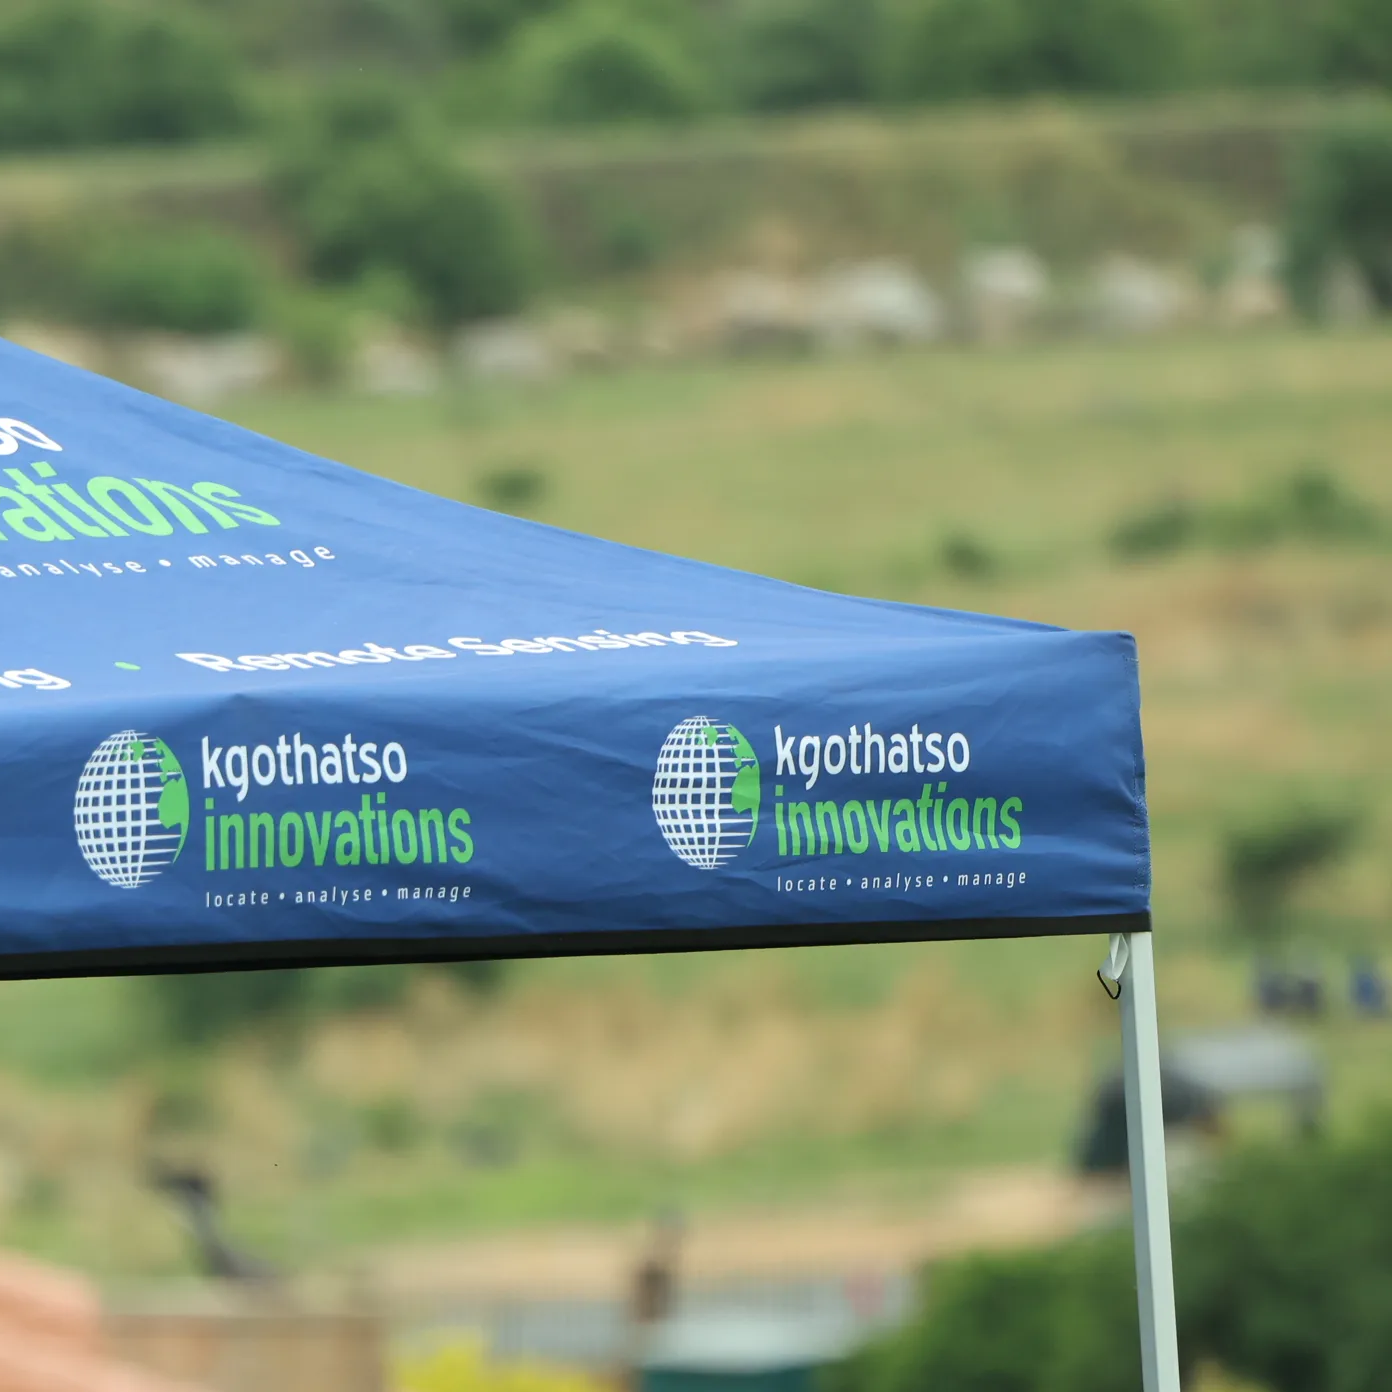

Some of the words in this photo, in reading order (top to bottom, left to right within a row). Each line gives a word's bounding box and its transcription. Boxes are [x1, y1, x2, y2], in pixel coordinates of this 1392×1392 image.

[188, 545, 336, 569] manage
[174, 642, 456, 672] Remote
[448, 629, 738, 656] Sensing
[202, 732, 407, 802] kgothatso
[774, 722, 969, 790] kgothatso
[204, 792, 474, 871] innovations
[774, 781, 1022, 856] innovations
[206, 891, 269, 908] locate
[295, 886, 372, 905] analyse
[397, 884, 472, 902] manage
[777, 875, 837, 892] locate
[861, 872, 934, 892] analyse
[957, 871, 1026, 889] manage
